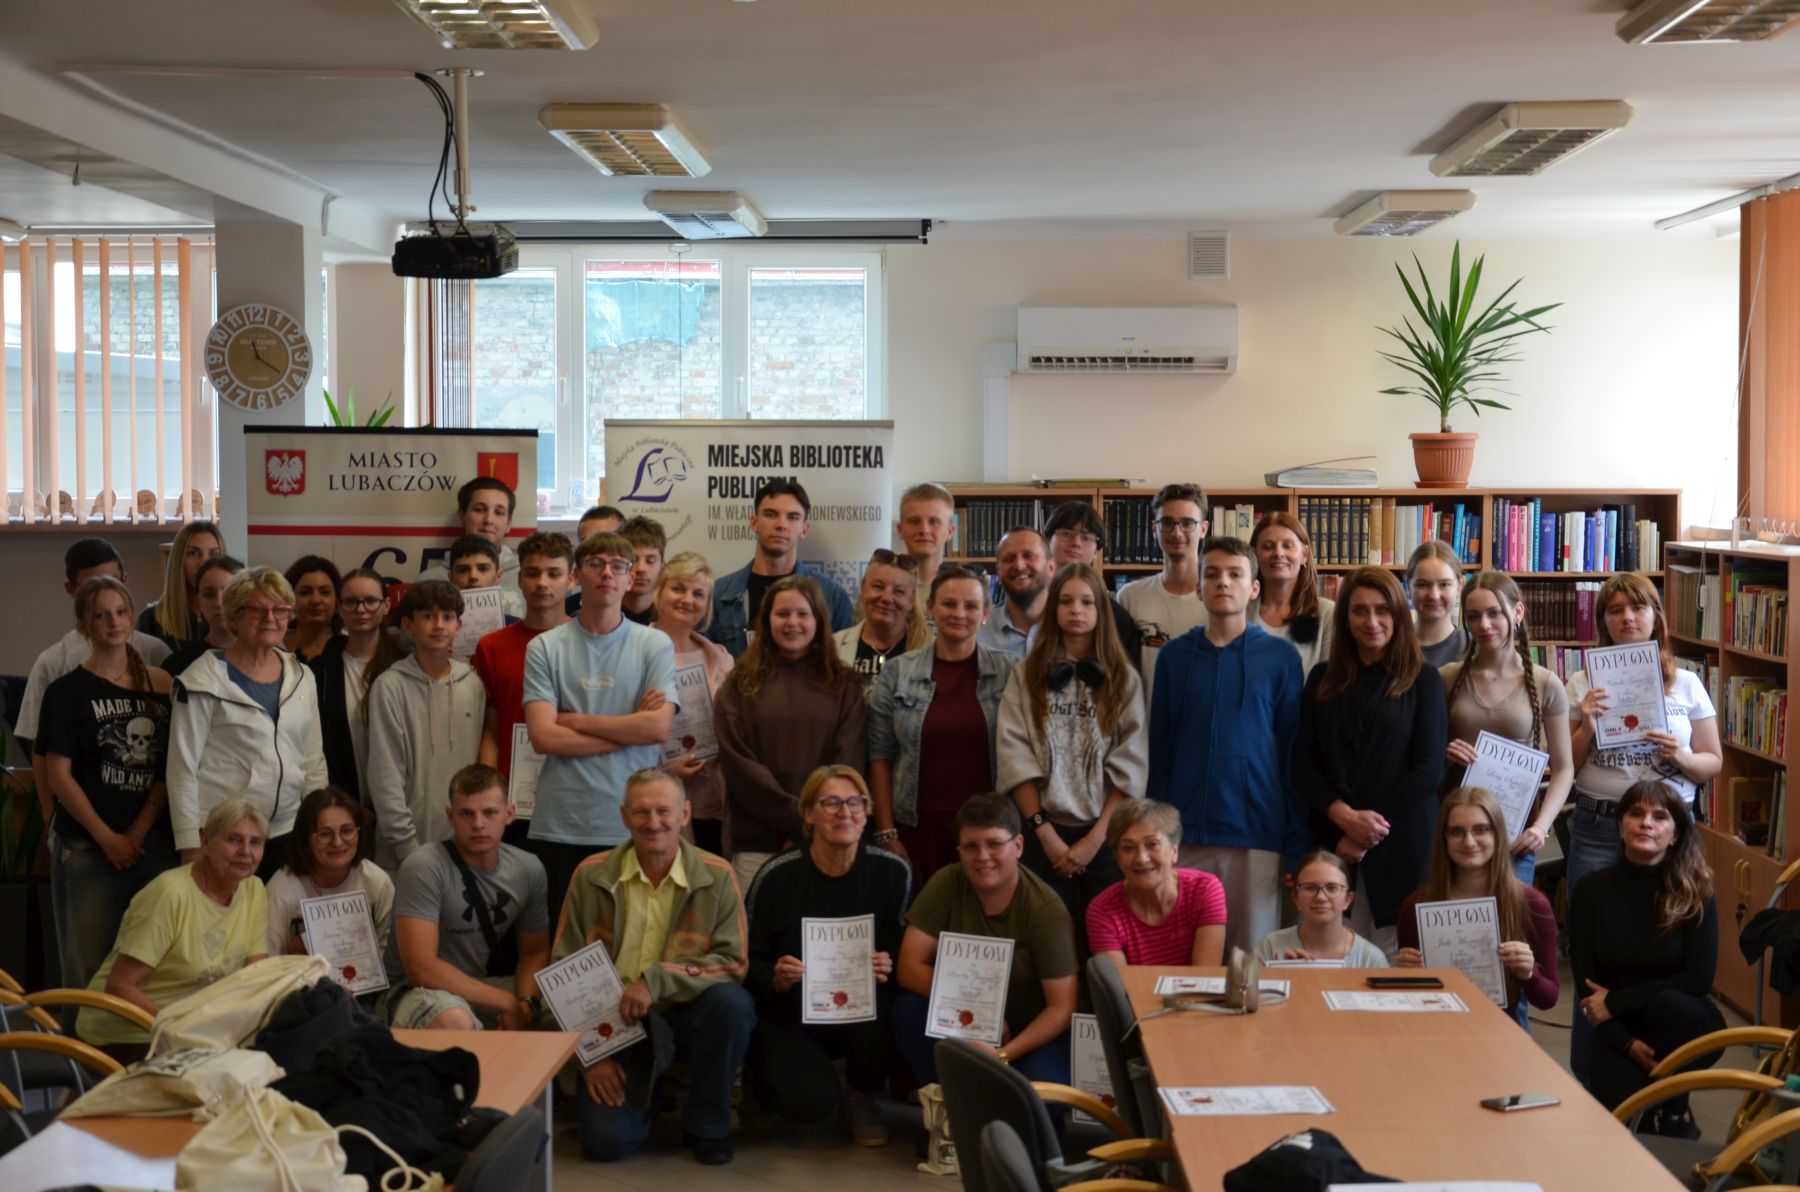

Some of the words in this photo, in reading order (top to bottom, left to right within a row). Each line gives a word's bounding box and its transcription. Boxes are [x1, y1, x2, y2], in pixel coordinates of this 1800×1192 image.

[226, 311, 242, 327] 11
[247, 305, 264, 321] 12
[273, 313, 286, 327] 1
[210, 328, 229, 344] 10
[287, 328, 303, 343] 2
[208, 353, 223, 364] 9
[295, 351, 309, 361] 3
[214, 375, 229, 388] 8
[292, 373, 303, 386] 4
[236, 389, 248, 405] 7
[257, 394, 266, 408] 6
[277, 387, 290, 404] 5
[348, 452, 437, 469] MIASTO
[708, 444, 783, 468] MIEJSKA
[790, 445, 884, 469] BIBLIOTEKA
[328, 469, 457, 492] LUBACZÓW
[708, 525, 718, 540] W
[722, 525, 757, 541] LUBAC
[1594, 649, 1653, 671] DYPLOM
[91, 699, 132, 718] MADE
[1482, 741, 1540, 773] DYPLOM
[101, 764, 125, 784] WILD
[310, 899, 364, 920] DYPLOM
[1425, 907, 1491, 927] DYPLOM
[810, 923, 869, 941] DYPLOM
[945, 941, 1006, 962] DYPLOM
[545, 951, 604, 992] DYPLOM
[1080, 1023, 1096, 1040] DY
